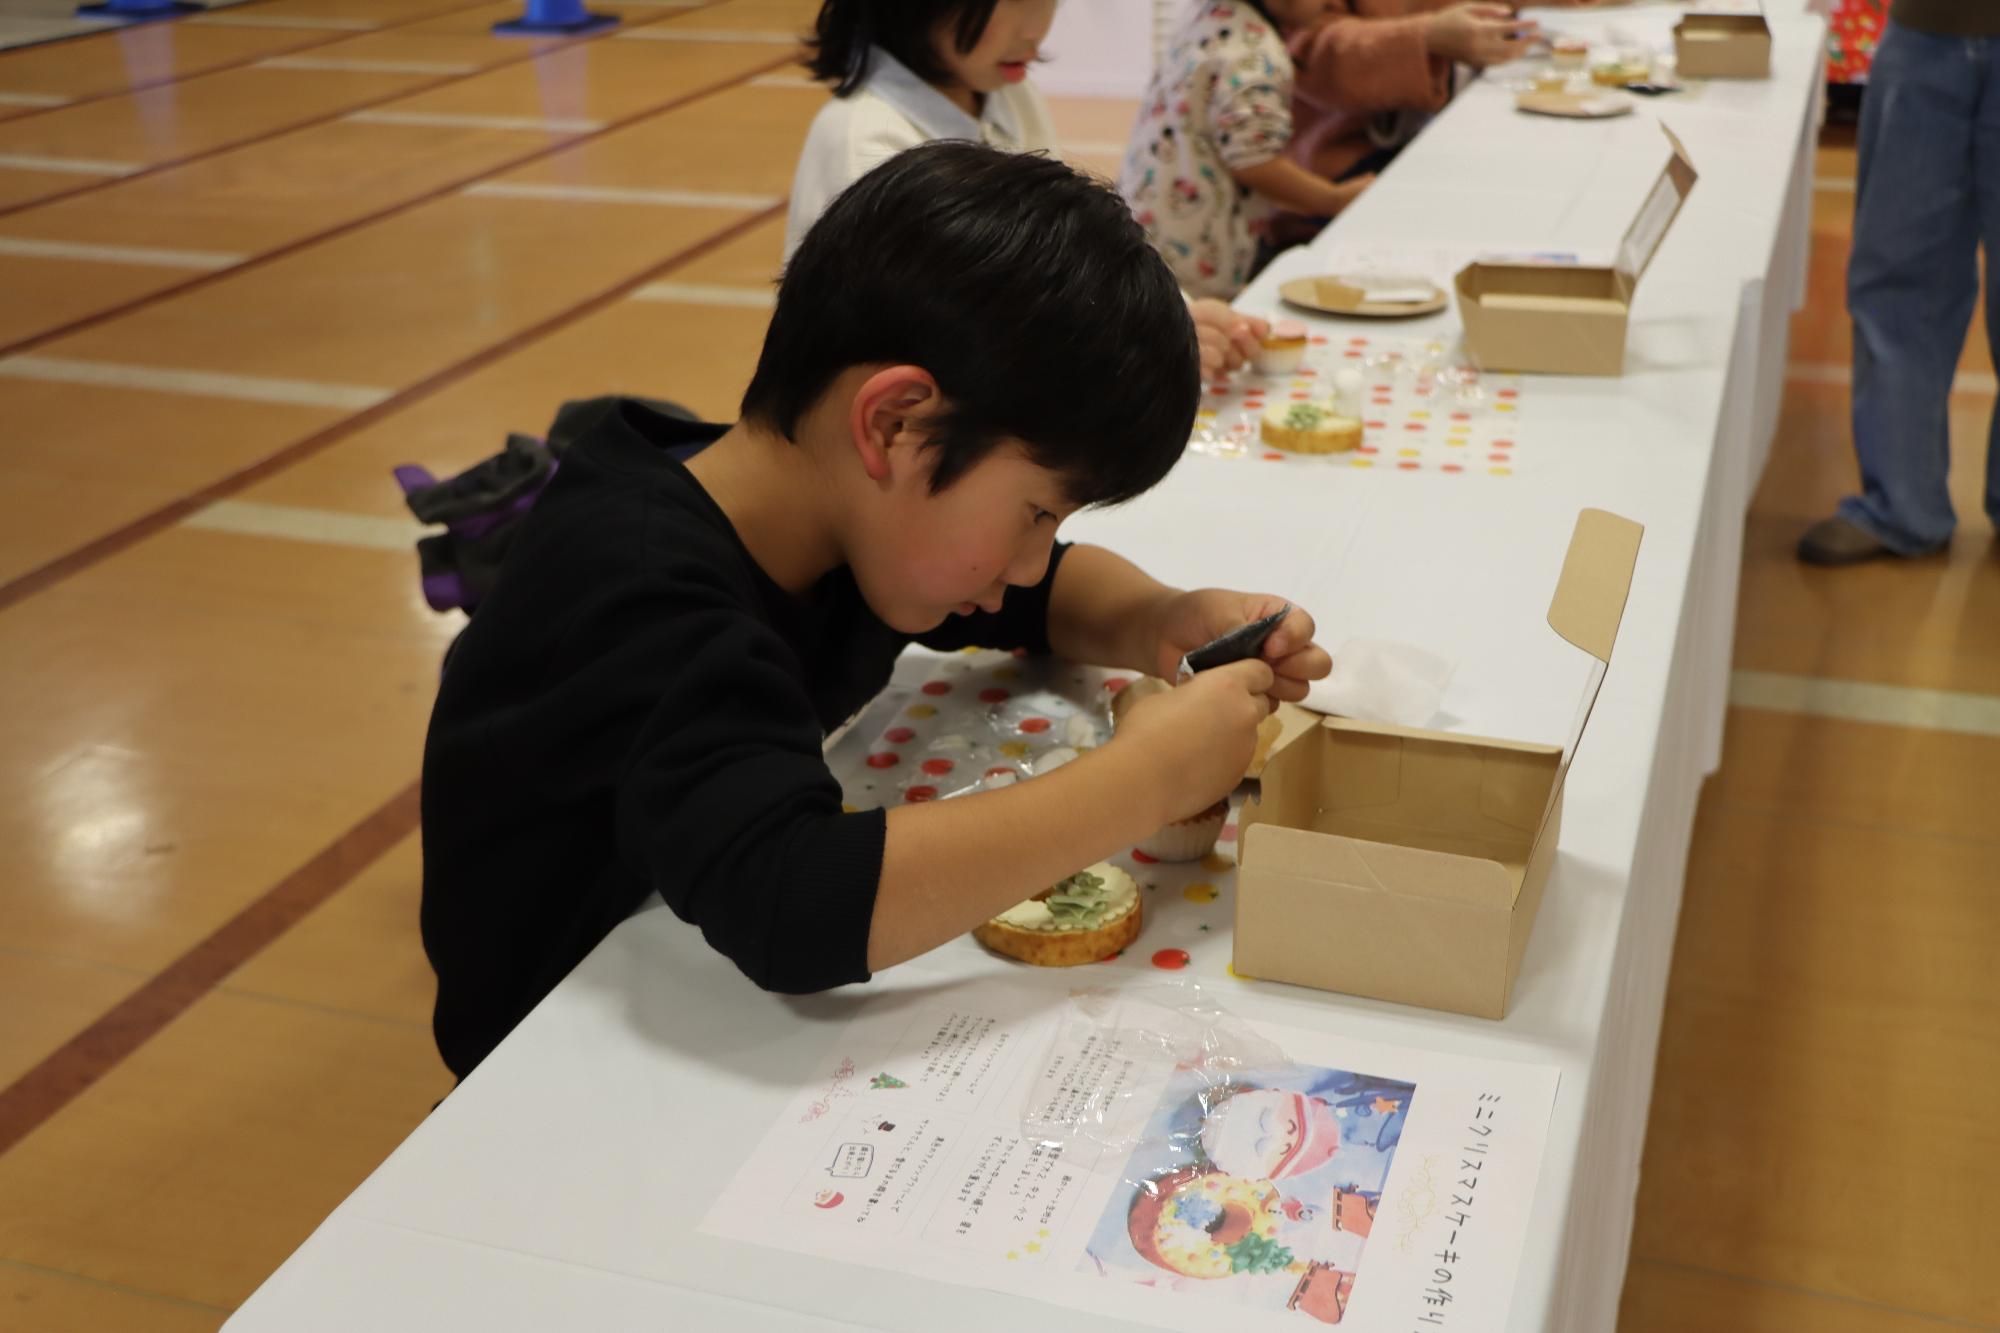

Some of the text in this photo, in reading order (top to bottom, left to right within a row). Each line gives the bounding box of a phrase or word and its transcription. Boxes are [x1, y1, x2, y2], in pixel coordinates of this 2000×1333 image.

[1413, 1092, 1500, 1333] ミニクリスマスケーキの作り
